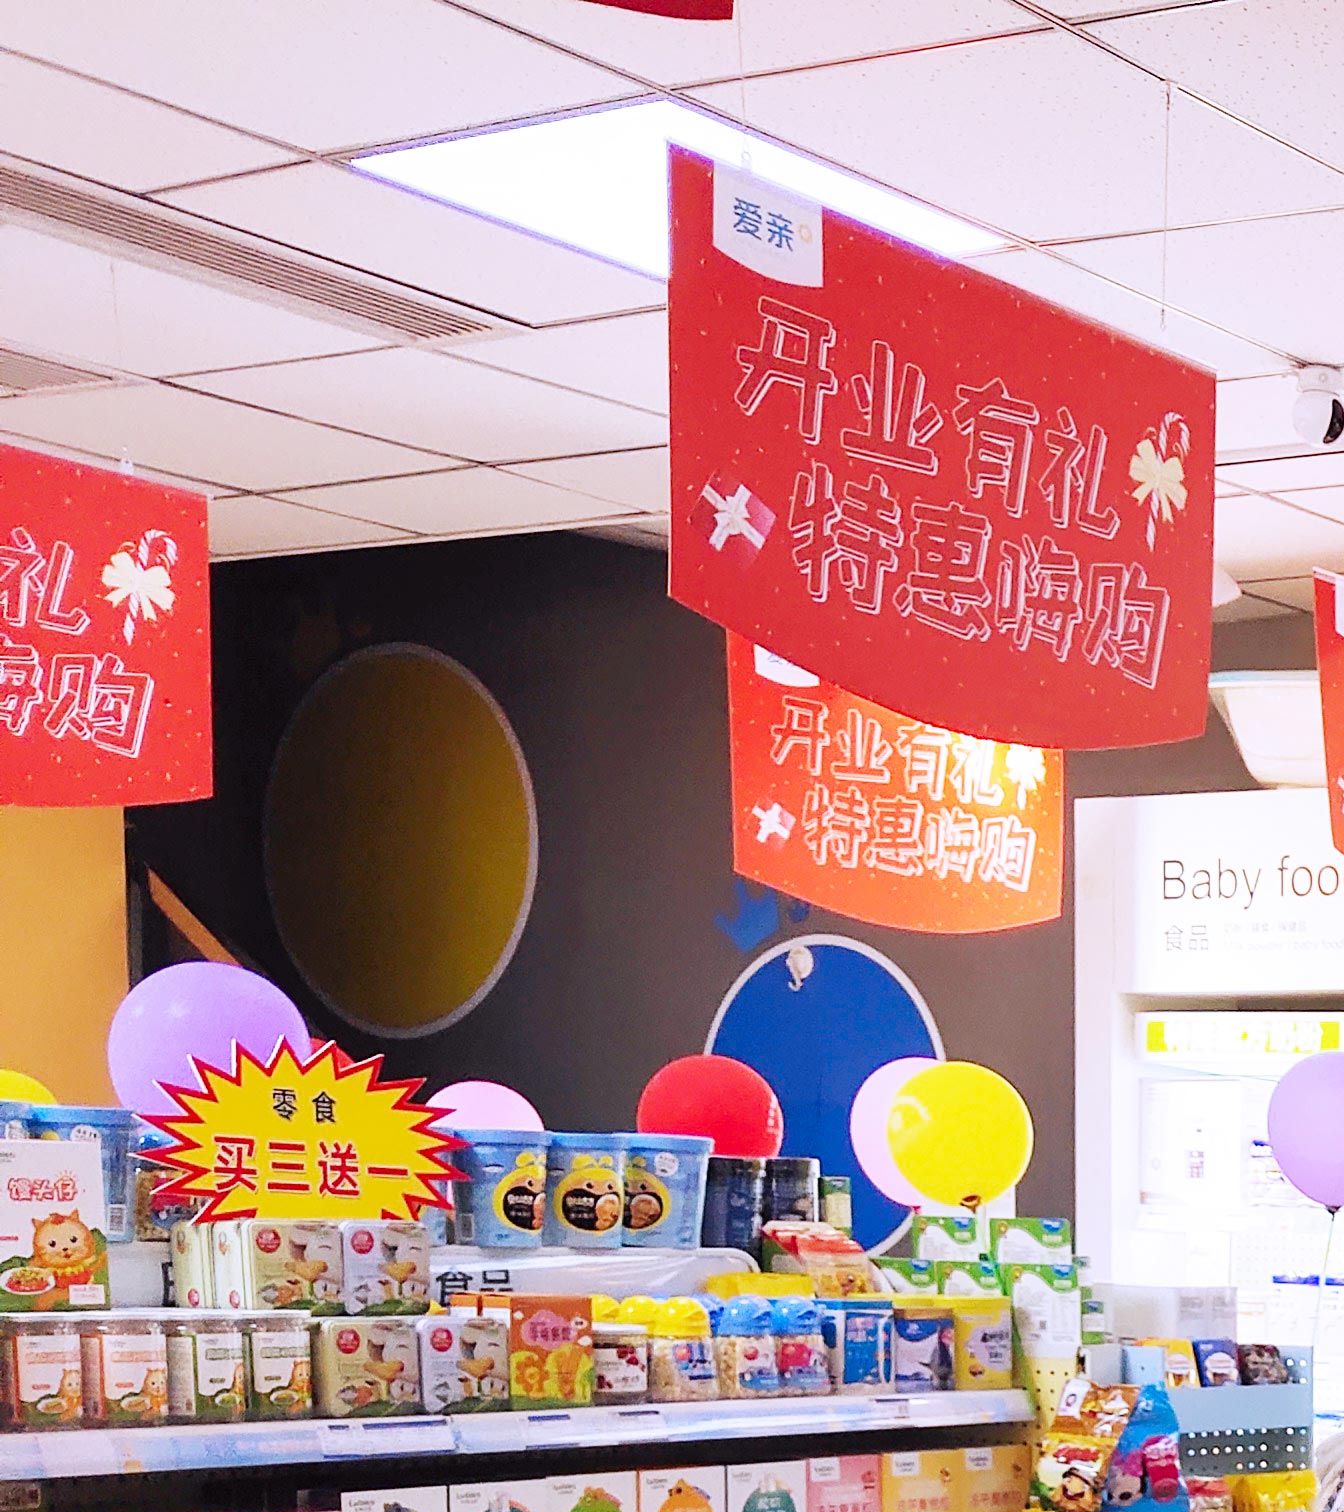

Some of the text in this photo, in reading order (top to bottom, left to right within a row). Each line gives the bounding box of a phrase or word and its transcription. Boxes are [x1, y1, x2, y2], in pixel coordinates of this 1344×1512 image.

[733, 197, 796, 253] 爱亲
[734, 296, 1122, 540] 开业有礼
[789, 462, 1171, 690] 特惠嗨购
[769, 695, 1004, 806] 开业有礼
[803, 783, 1037, 893] 特惠嗨购
[1161, 857, 1261, 910] Baby
[271, 1087, 338, 1124] 零食
[212, 1135, 410, 1198] 买三送一
